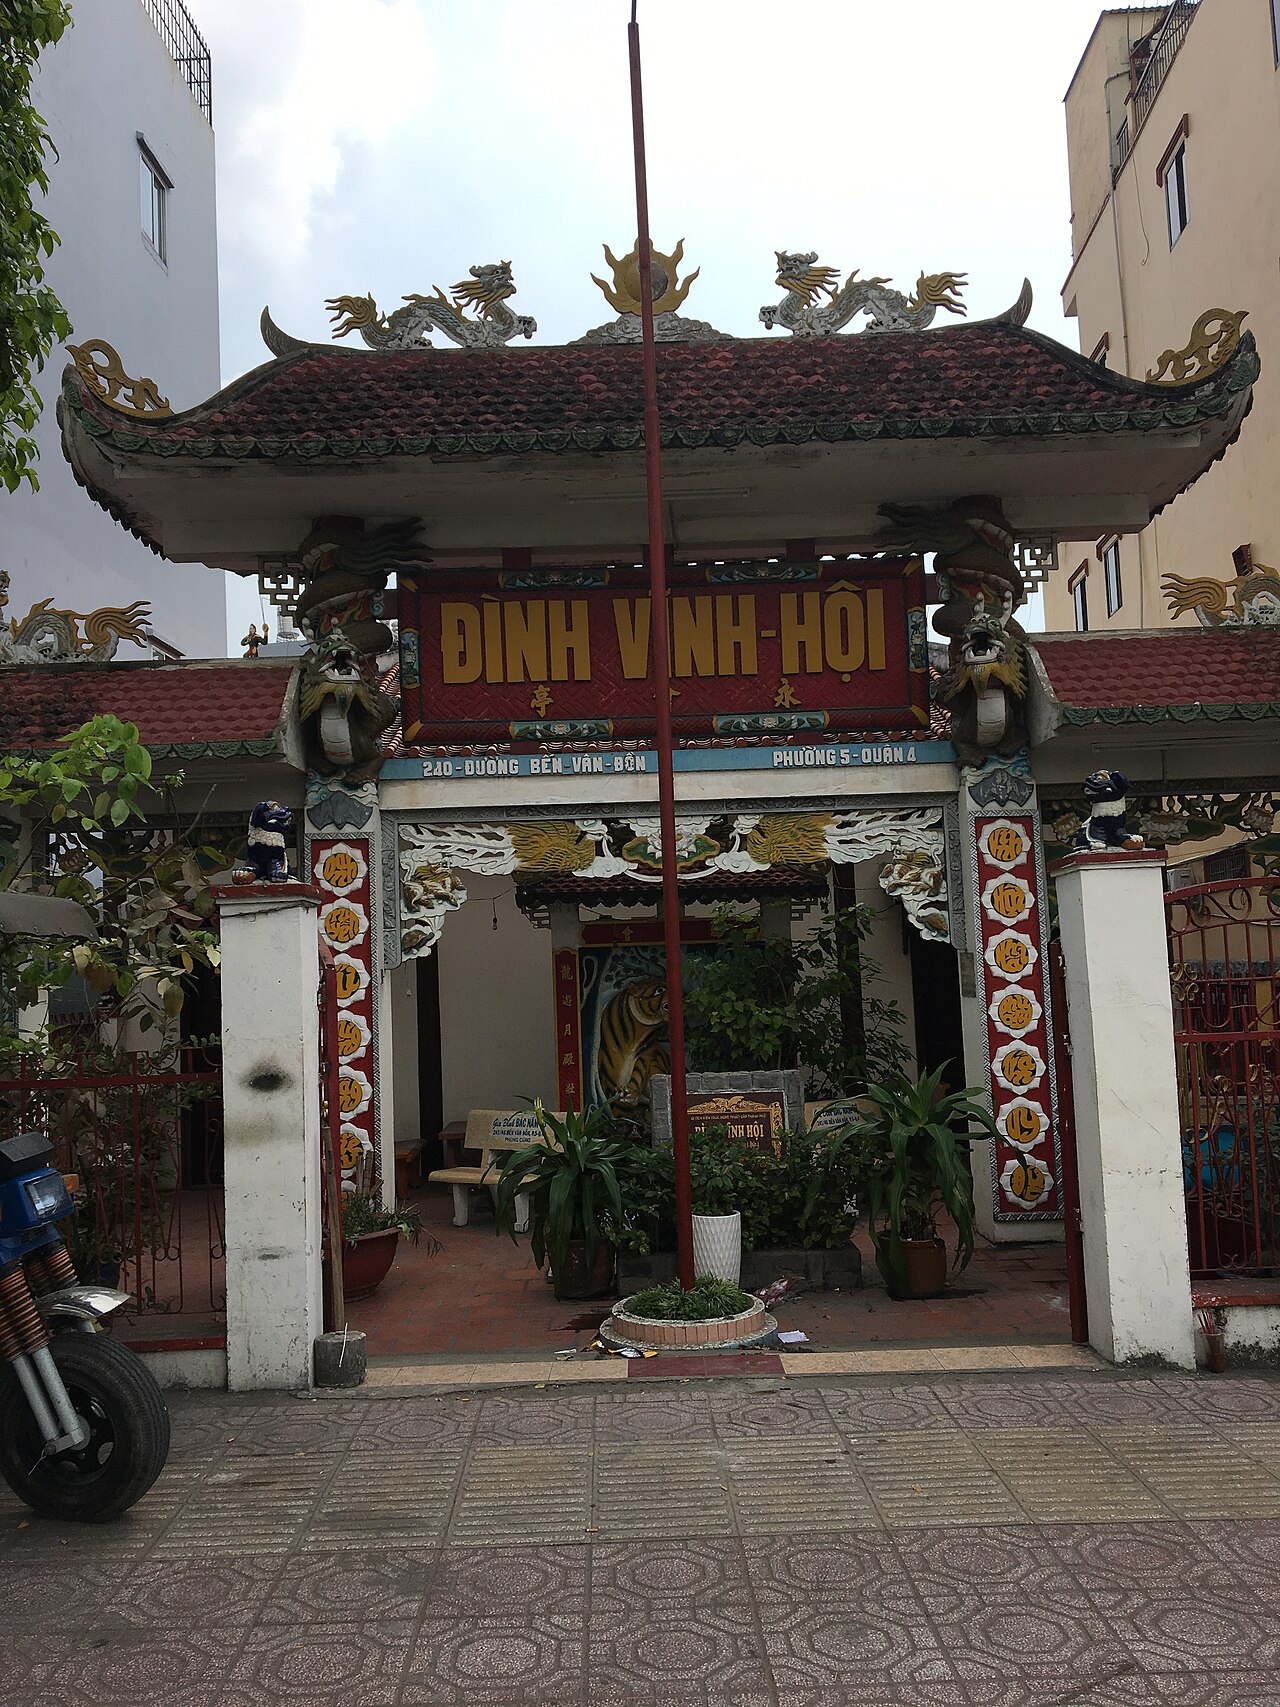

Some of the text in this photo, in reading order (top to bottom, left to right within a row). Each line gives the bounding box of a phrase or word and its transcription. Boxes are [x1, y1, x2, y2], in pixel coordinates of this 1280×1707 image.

[440, 580, 887, 684] ĐÌNH VNH-HỘI
[531, 678, 801, 718] 亭 永
[773, 746, 836, 766] PHƯỜNG
[907, 746, 917, 762] 4
[746, 1121, 764, 1140] HỘI
